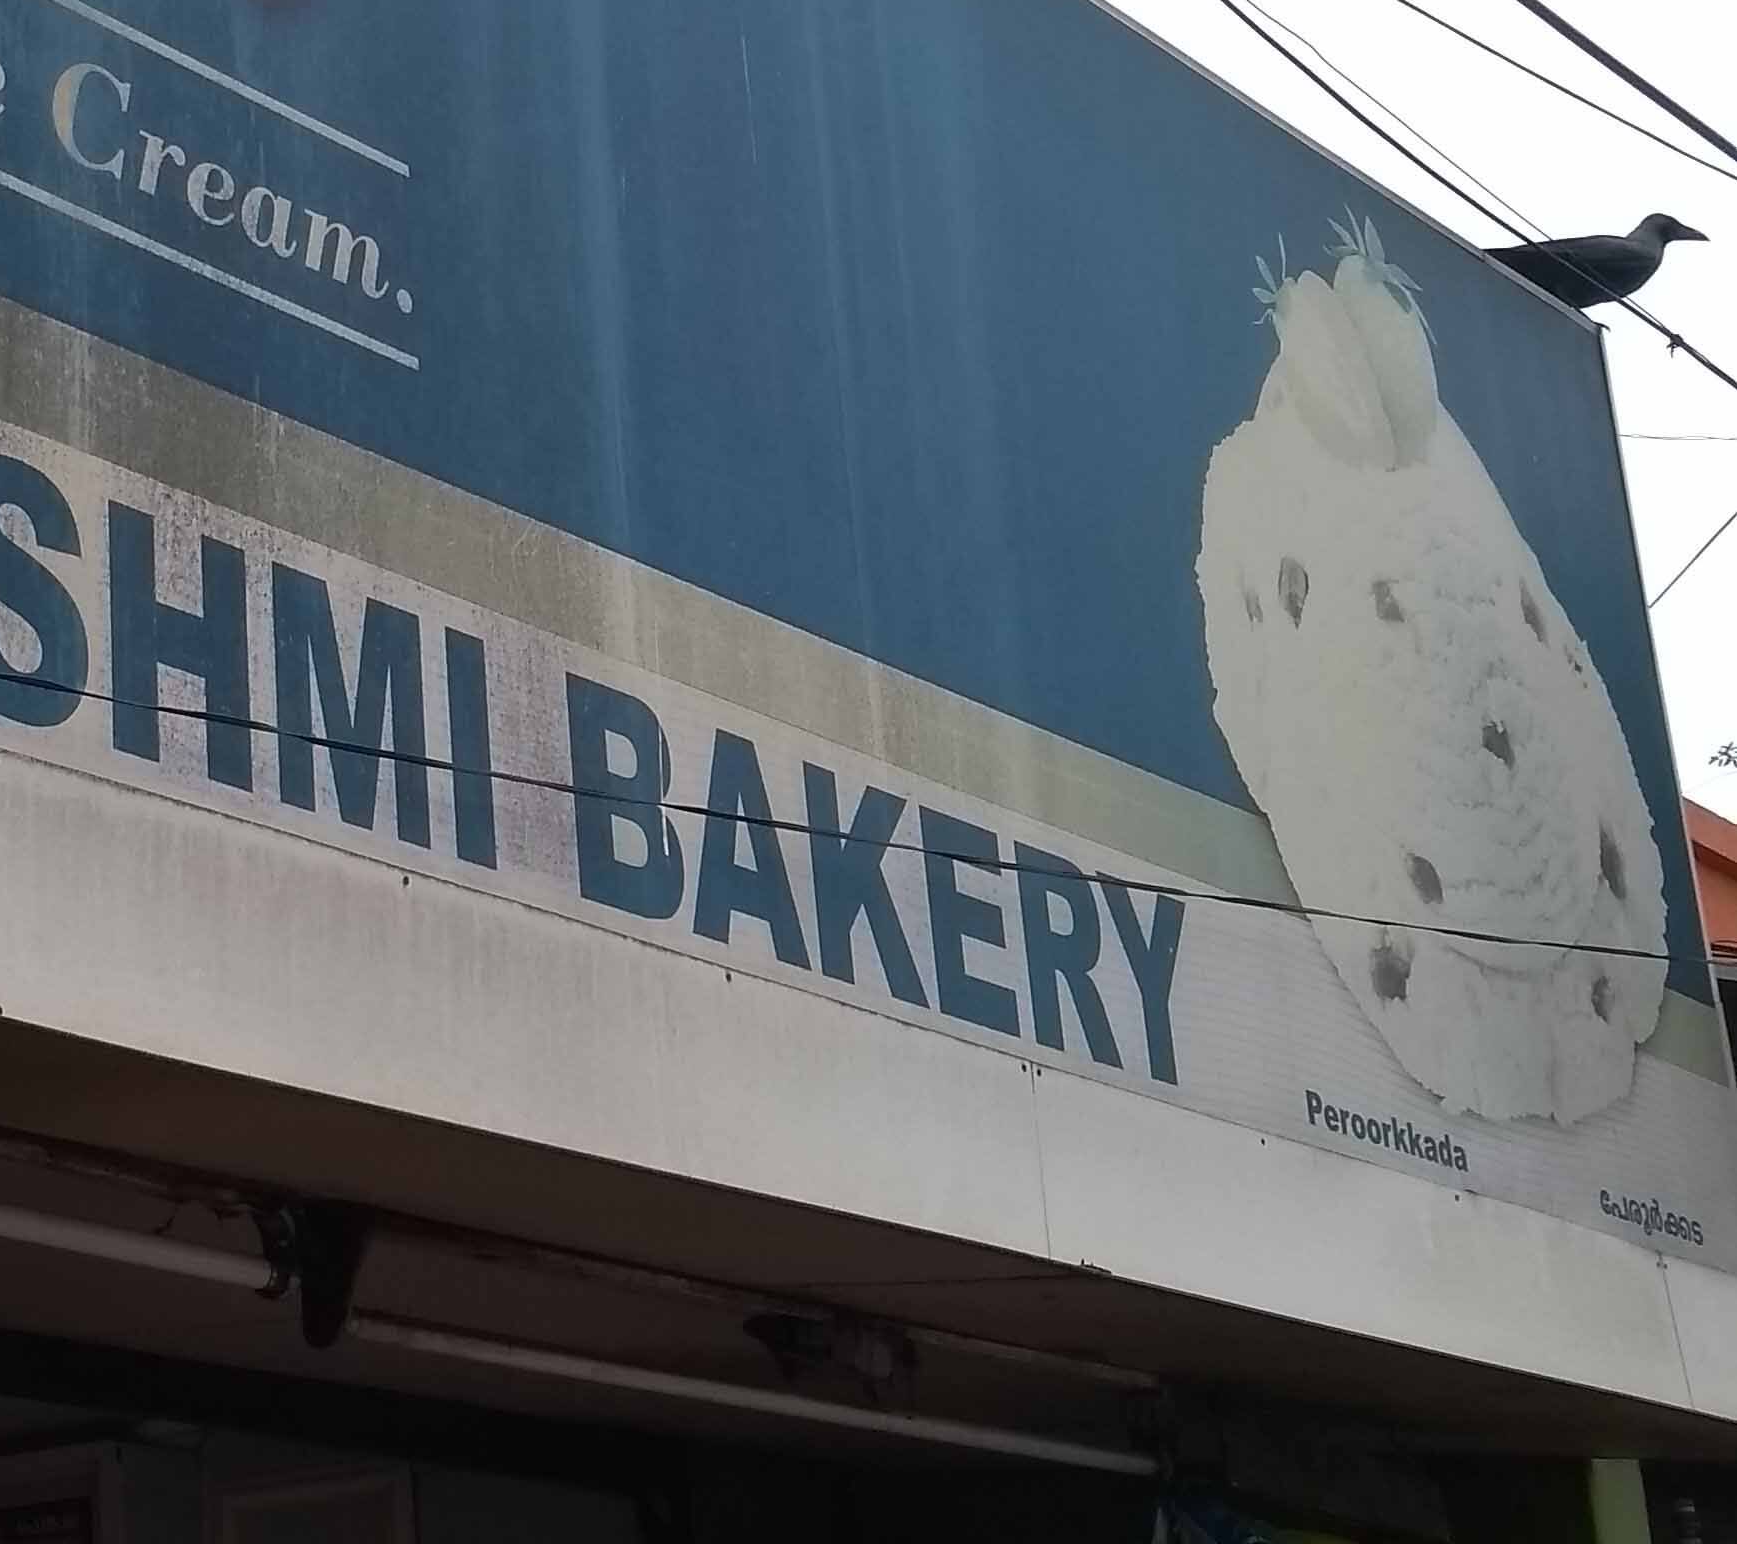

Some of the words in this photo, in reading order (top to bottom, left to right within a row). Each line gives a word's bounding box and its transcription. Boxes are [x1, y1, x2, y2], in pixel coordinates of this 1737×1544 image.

[50, 59, 414, 315] Cream.
[565, 672, 1186, 1086] BAKERY
[1305, 1089, 1470, 1173] Peroorkkada
